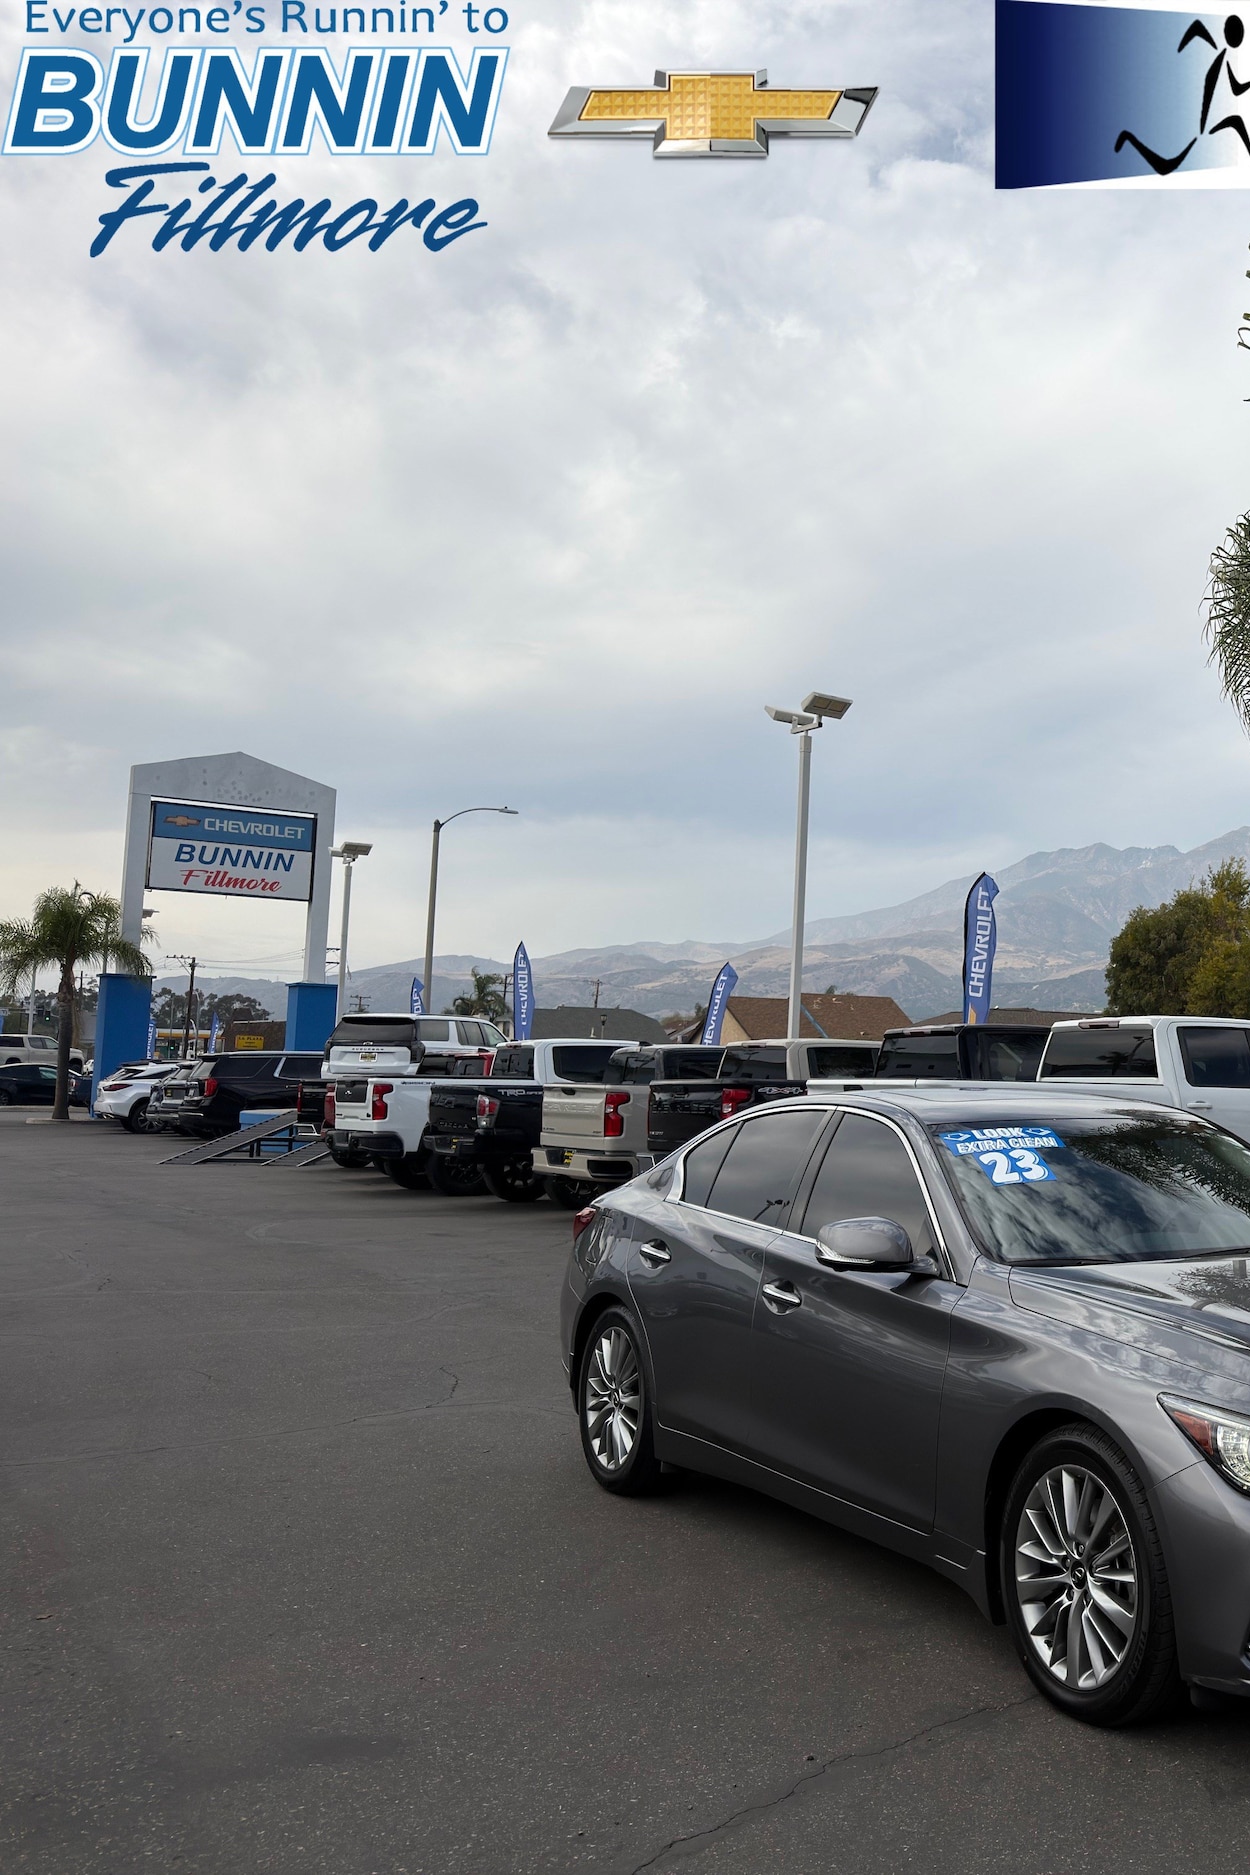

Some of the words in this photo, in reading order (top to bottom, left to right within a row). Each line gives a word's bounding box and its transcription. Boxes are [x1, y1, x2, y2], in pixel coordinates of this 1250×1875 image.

[203, 818, 305, 840] CHEVROLET
[174, 843, 295, 872] BUNNIN
[180, 869, 283, 893] Fillmore
[968, 886, 993, 998] CHEVROLET
[703, 973, 728, 1046] HEVROLET
[497, 1088, 526, 1097] TRD
[957, 1138, 1010, 1154] EXTRA
[1009, 1137, 1058, 1149] CLEAN
[971, 1127, 1029, 1140] LOOK
[979, 1149, 1048, 1184] 23
